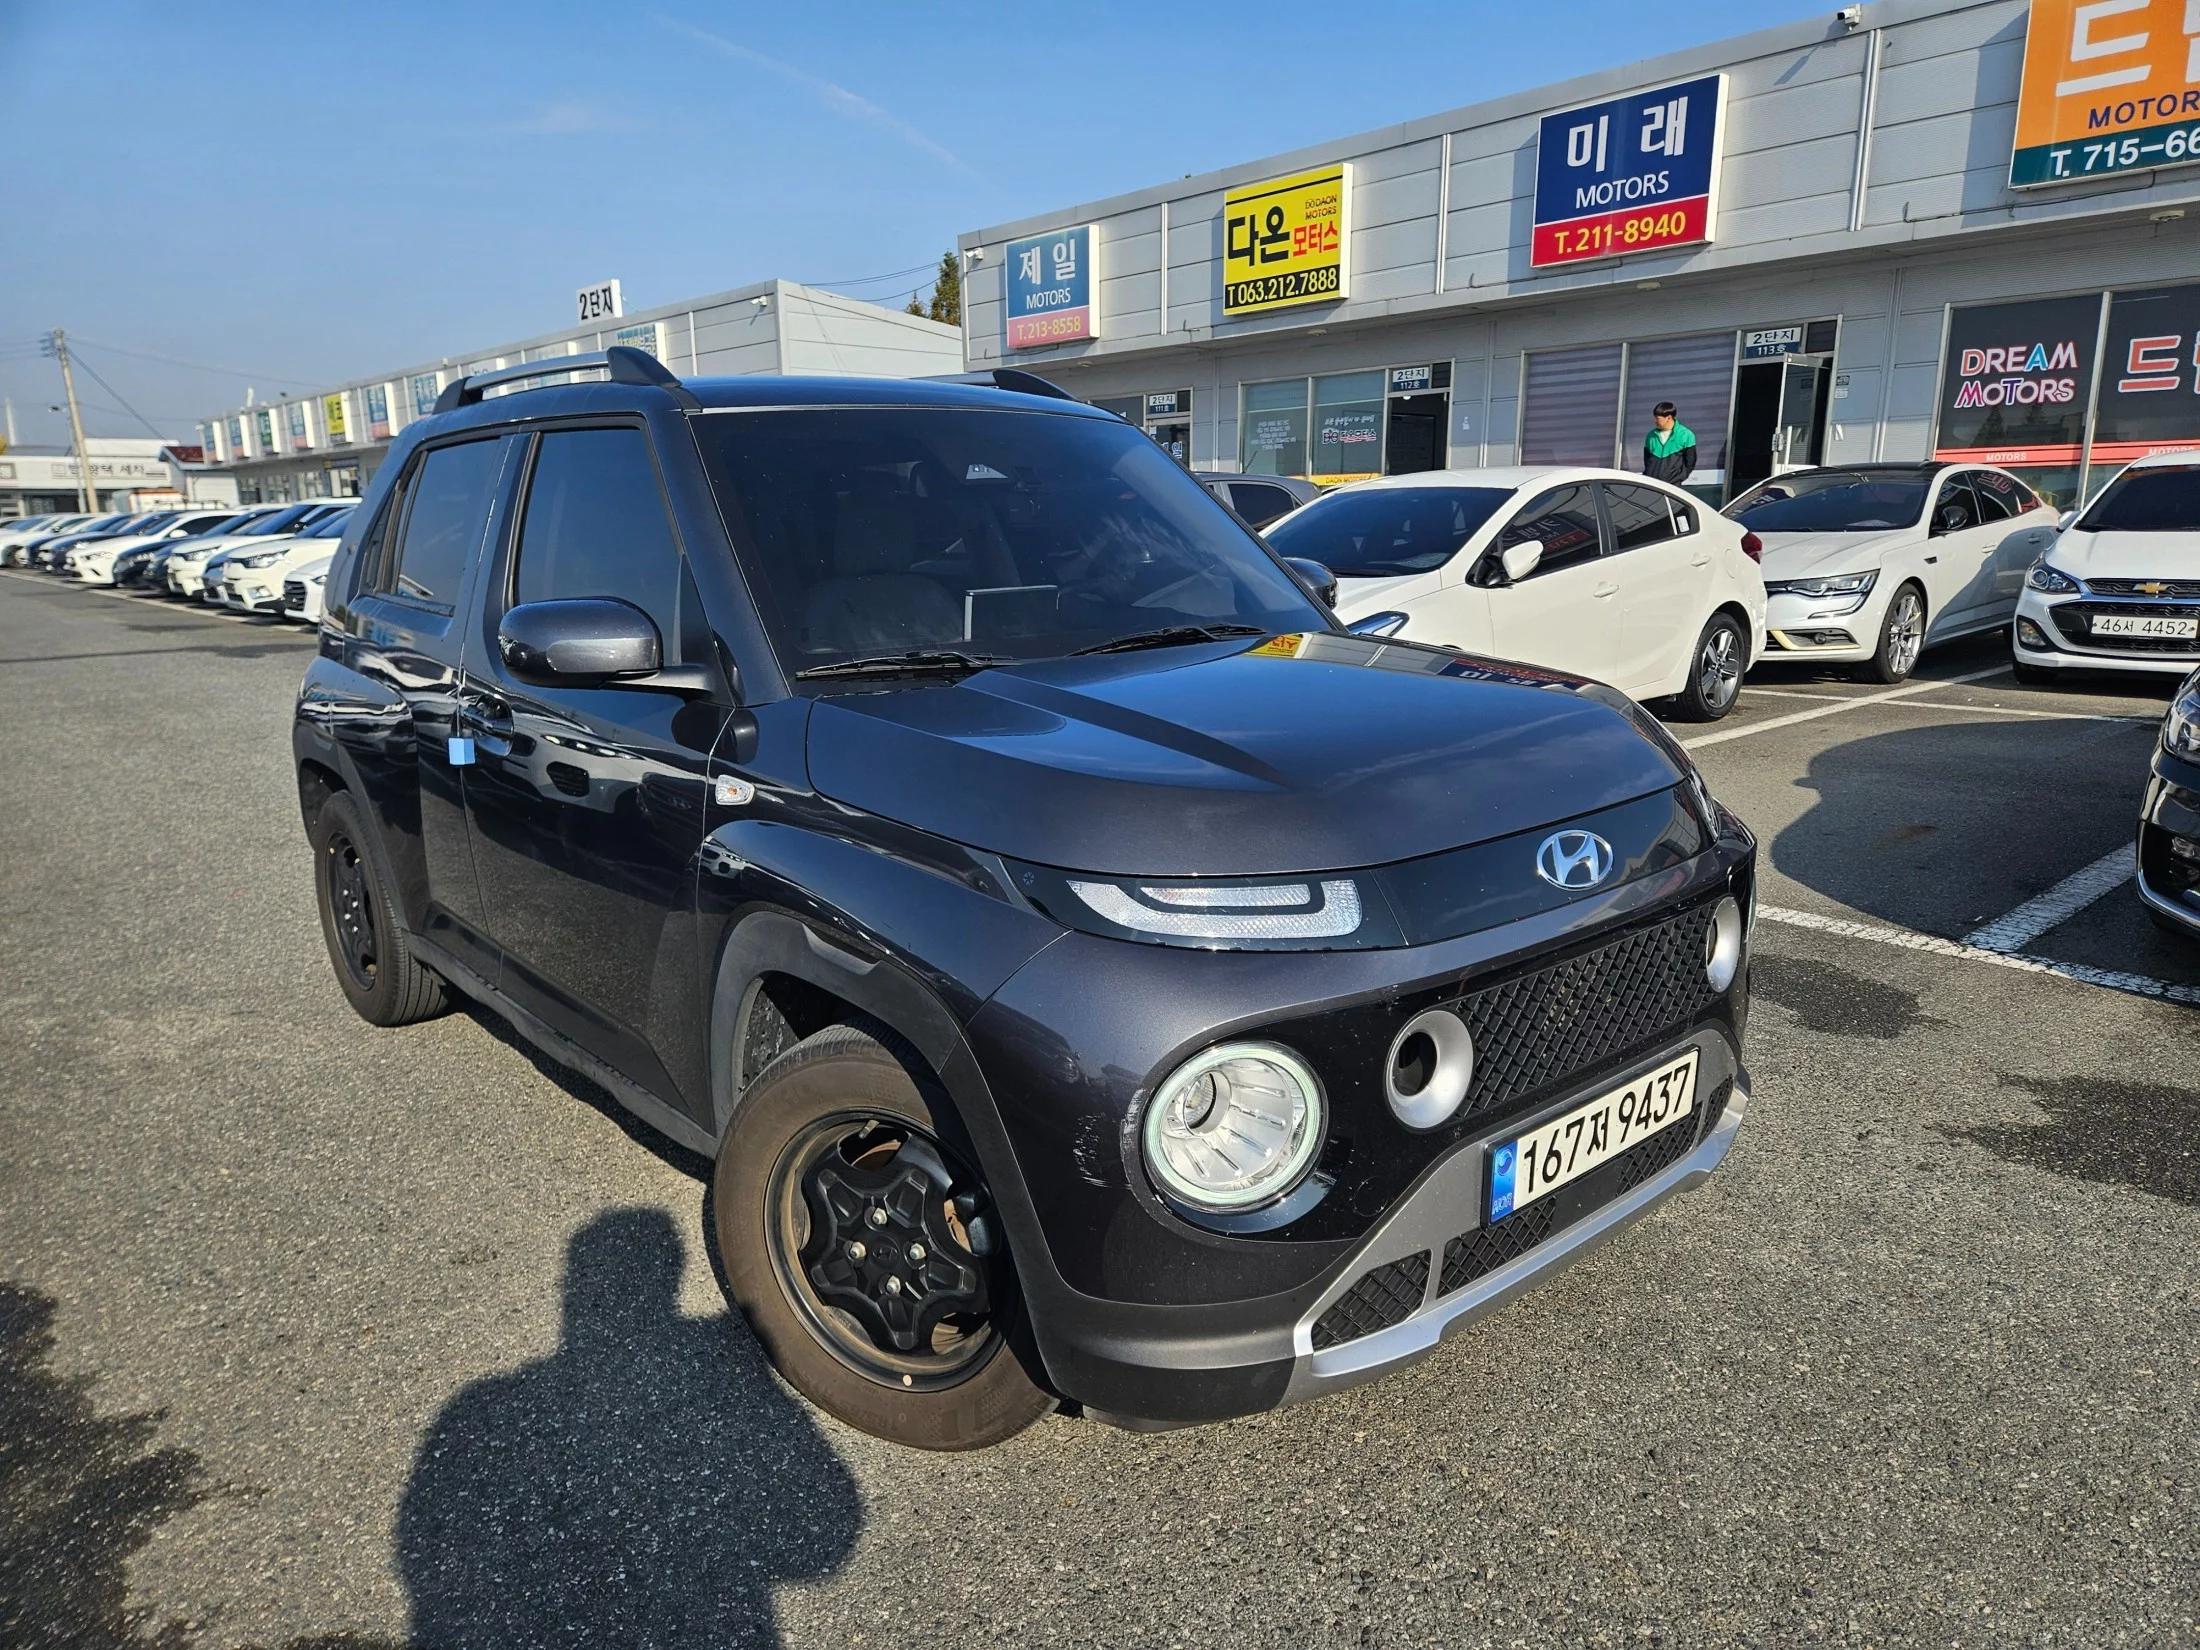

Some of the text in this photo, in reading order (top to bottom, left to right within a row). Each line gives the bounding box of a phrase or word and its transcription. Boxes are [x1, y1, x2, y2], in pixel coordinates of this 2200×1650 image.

[1576, 171, 1669, 209] MOTORS
[1228, 206, 1338, 267] 다온 모터스
[1026, 287, 1071, 310] MOTORS
[1238, 267, 1337, 304] 063.212.7888
[579, 286, 613, 320] 2단지
[1753, 329, 1794, 344] 2단지
[1758, 344, 1786, 356] 113호
[1960, 341, 2078, 376] DREAM
[1397, 369, 1424, 380] 2단지
[1400, 380, 1420, 390] 112호
[1954, 377, 2076, 408] MOTORS
[1986, 452, 2027, 462] MOTORS
[2101, 618, 2187, 636] 46서 4452
[1523, 1062, 1691, 1194] 167저 9437
